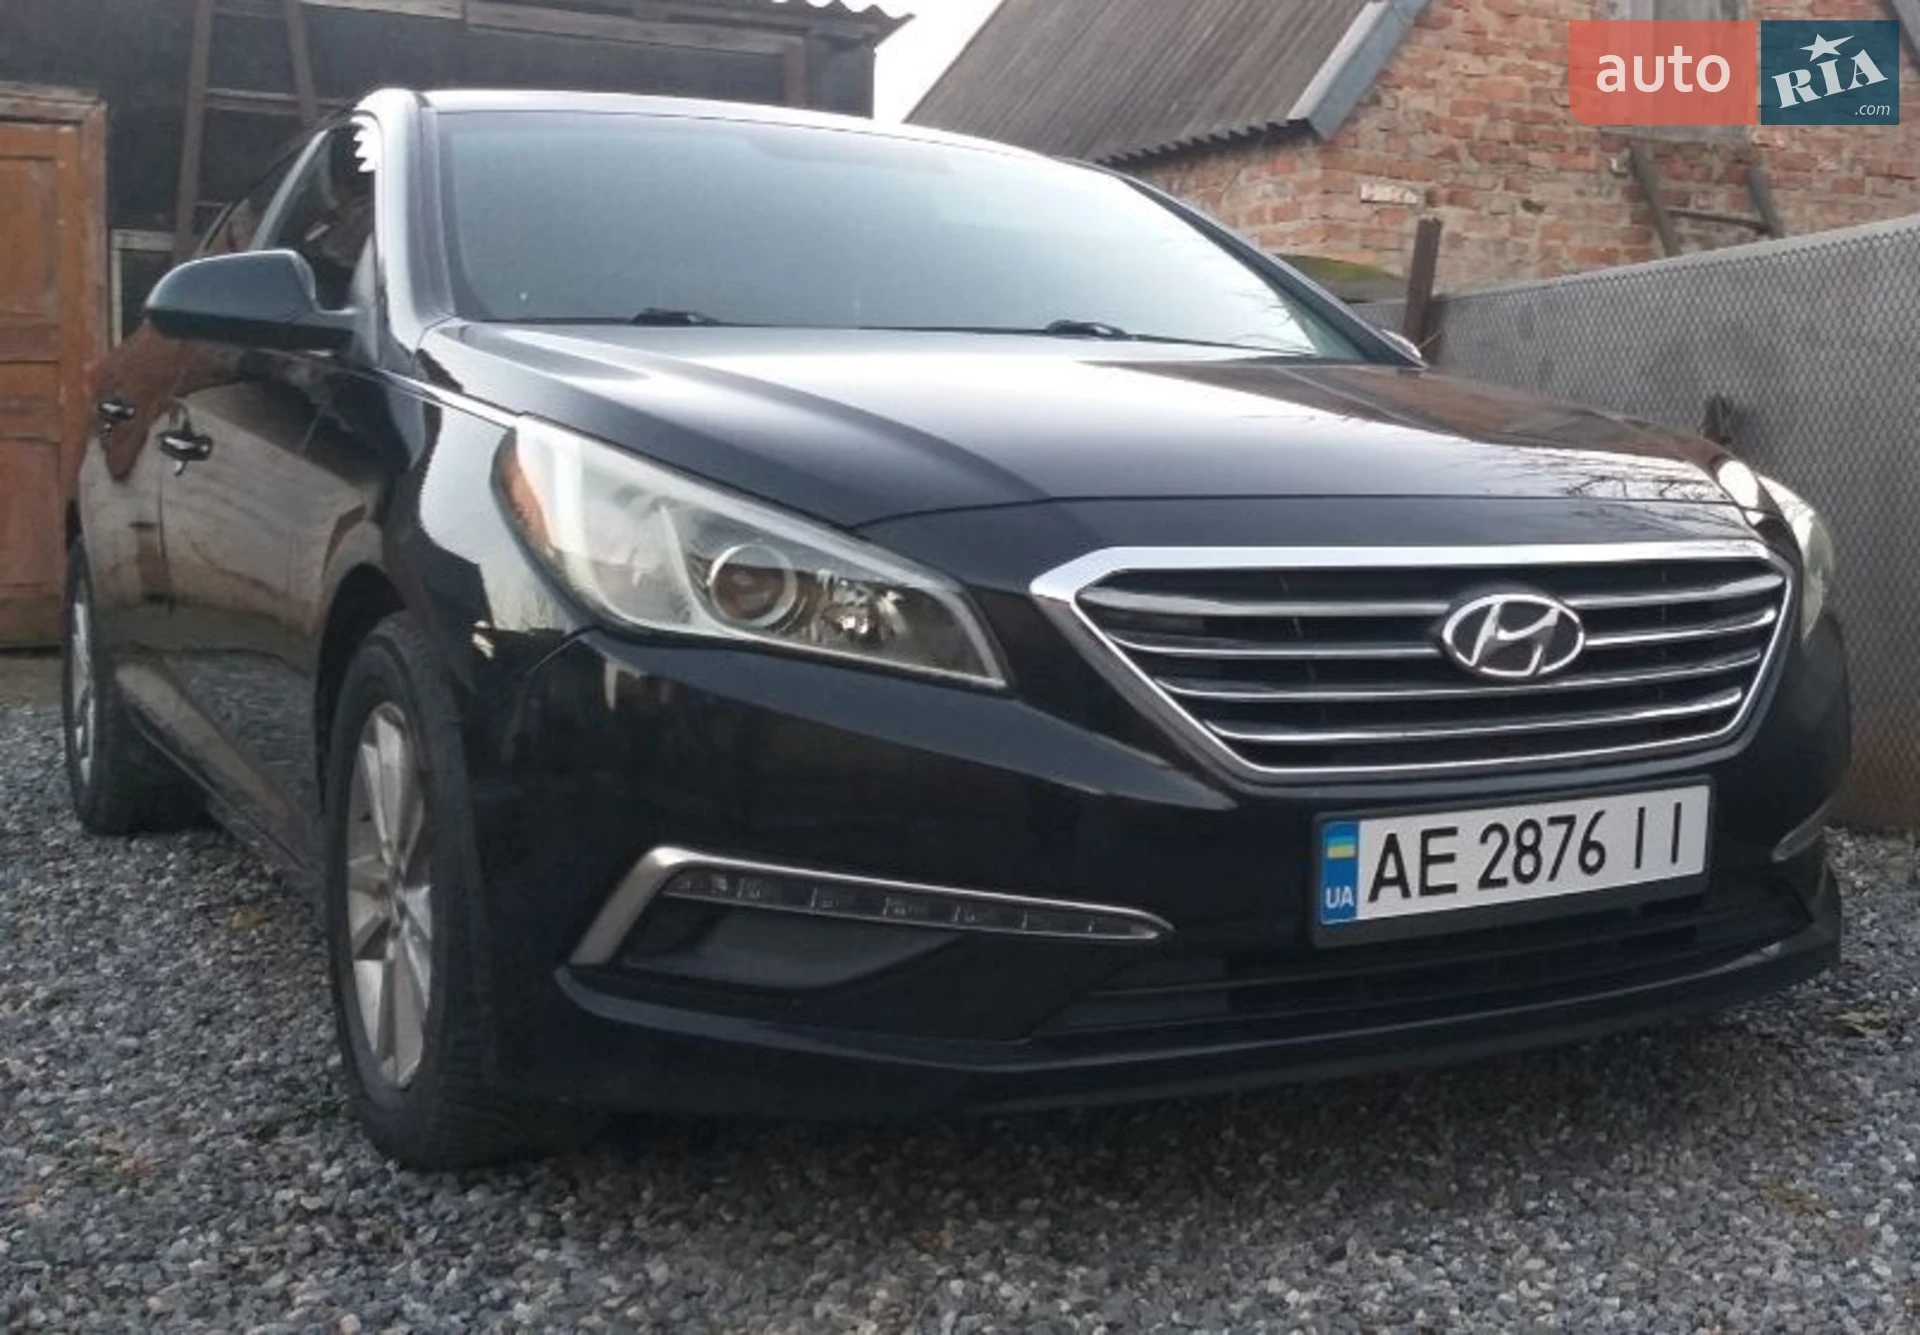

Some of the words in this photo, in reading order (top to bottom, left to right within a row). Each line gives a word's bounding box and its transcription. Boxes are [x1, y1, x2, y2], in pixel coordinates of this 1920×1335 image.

[1367, 825, 1459, 903] AE
[1477, 810, 1606, 890] 2876
[1325, 887, 1355, 909] UA
